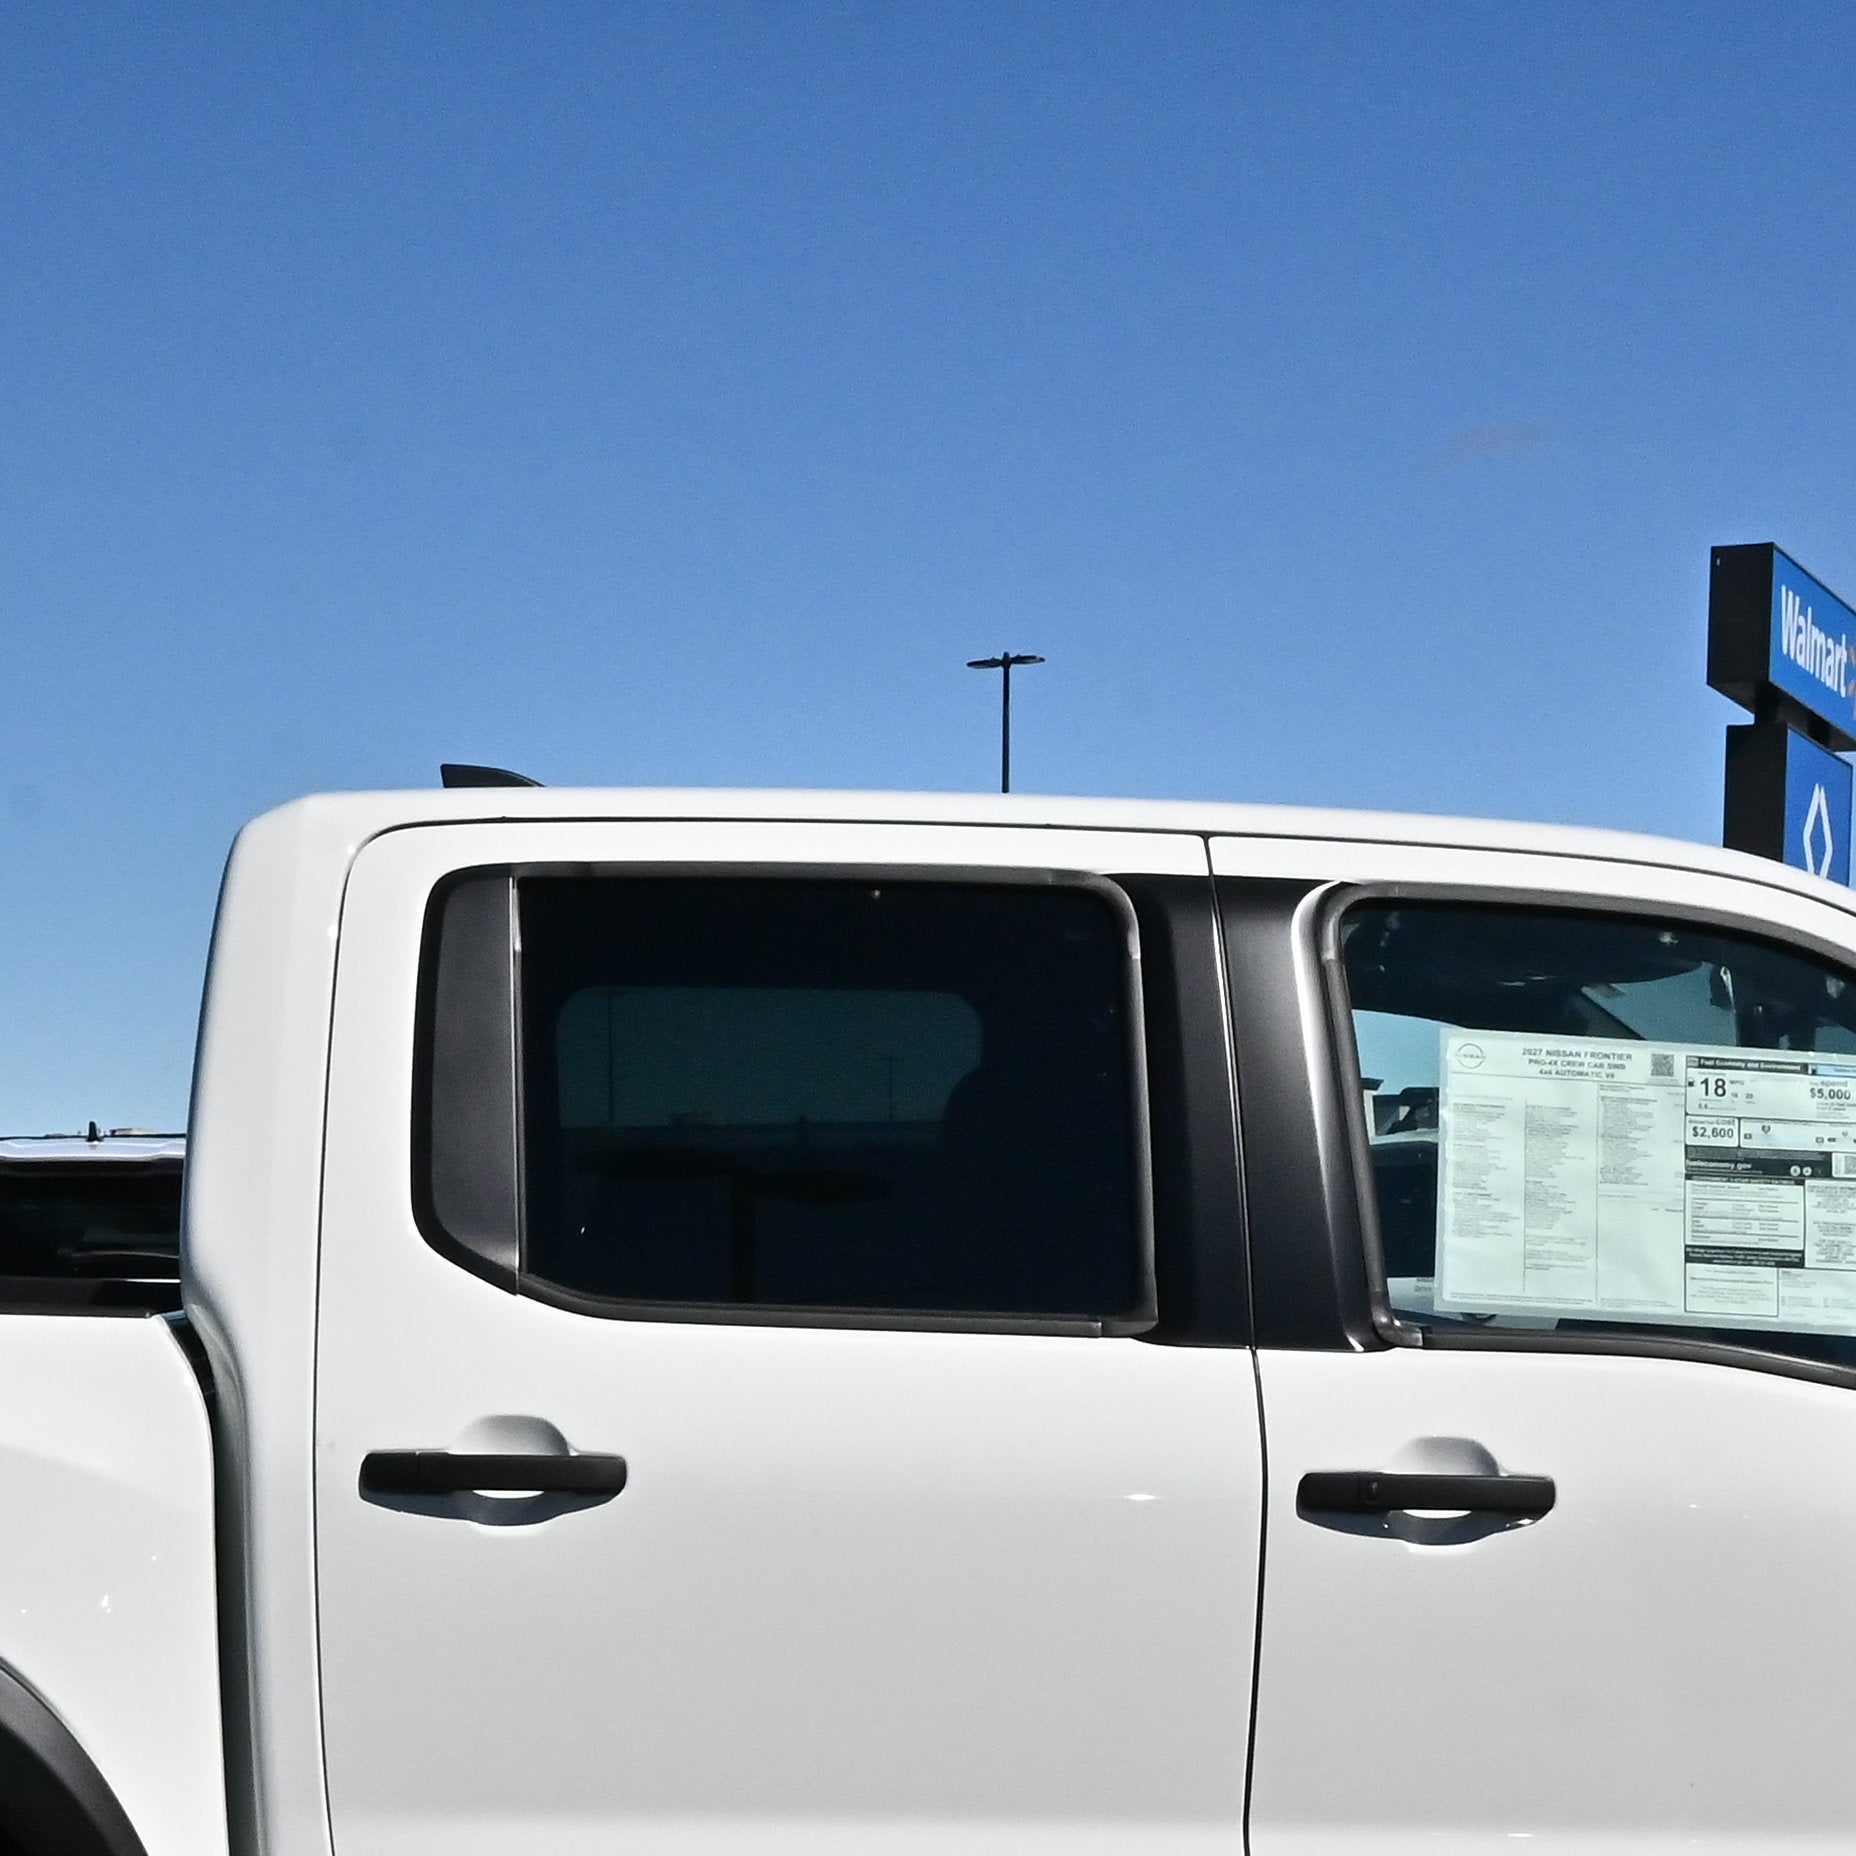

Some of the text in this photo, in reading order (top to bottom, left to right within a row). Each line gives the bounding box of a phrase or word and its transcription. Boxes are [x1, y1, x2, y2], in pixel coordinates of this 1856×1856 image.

[1781, 585, 1848, 698] Walmart
[1546, 1049, 1582, 1058] NISSAN
[1584, 1051, 1632, 1060] FRONTIER
[1700, 1077, 1726, 1097] 18
[1810, 1088, 1851, 1100] $5,000
[1692, 1126, 1734, 1139] $2,600
